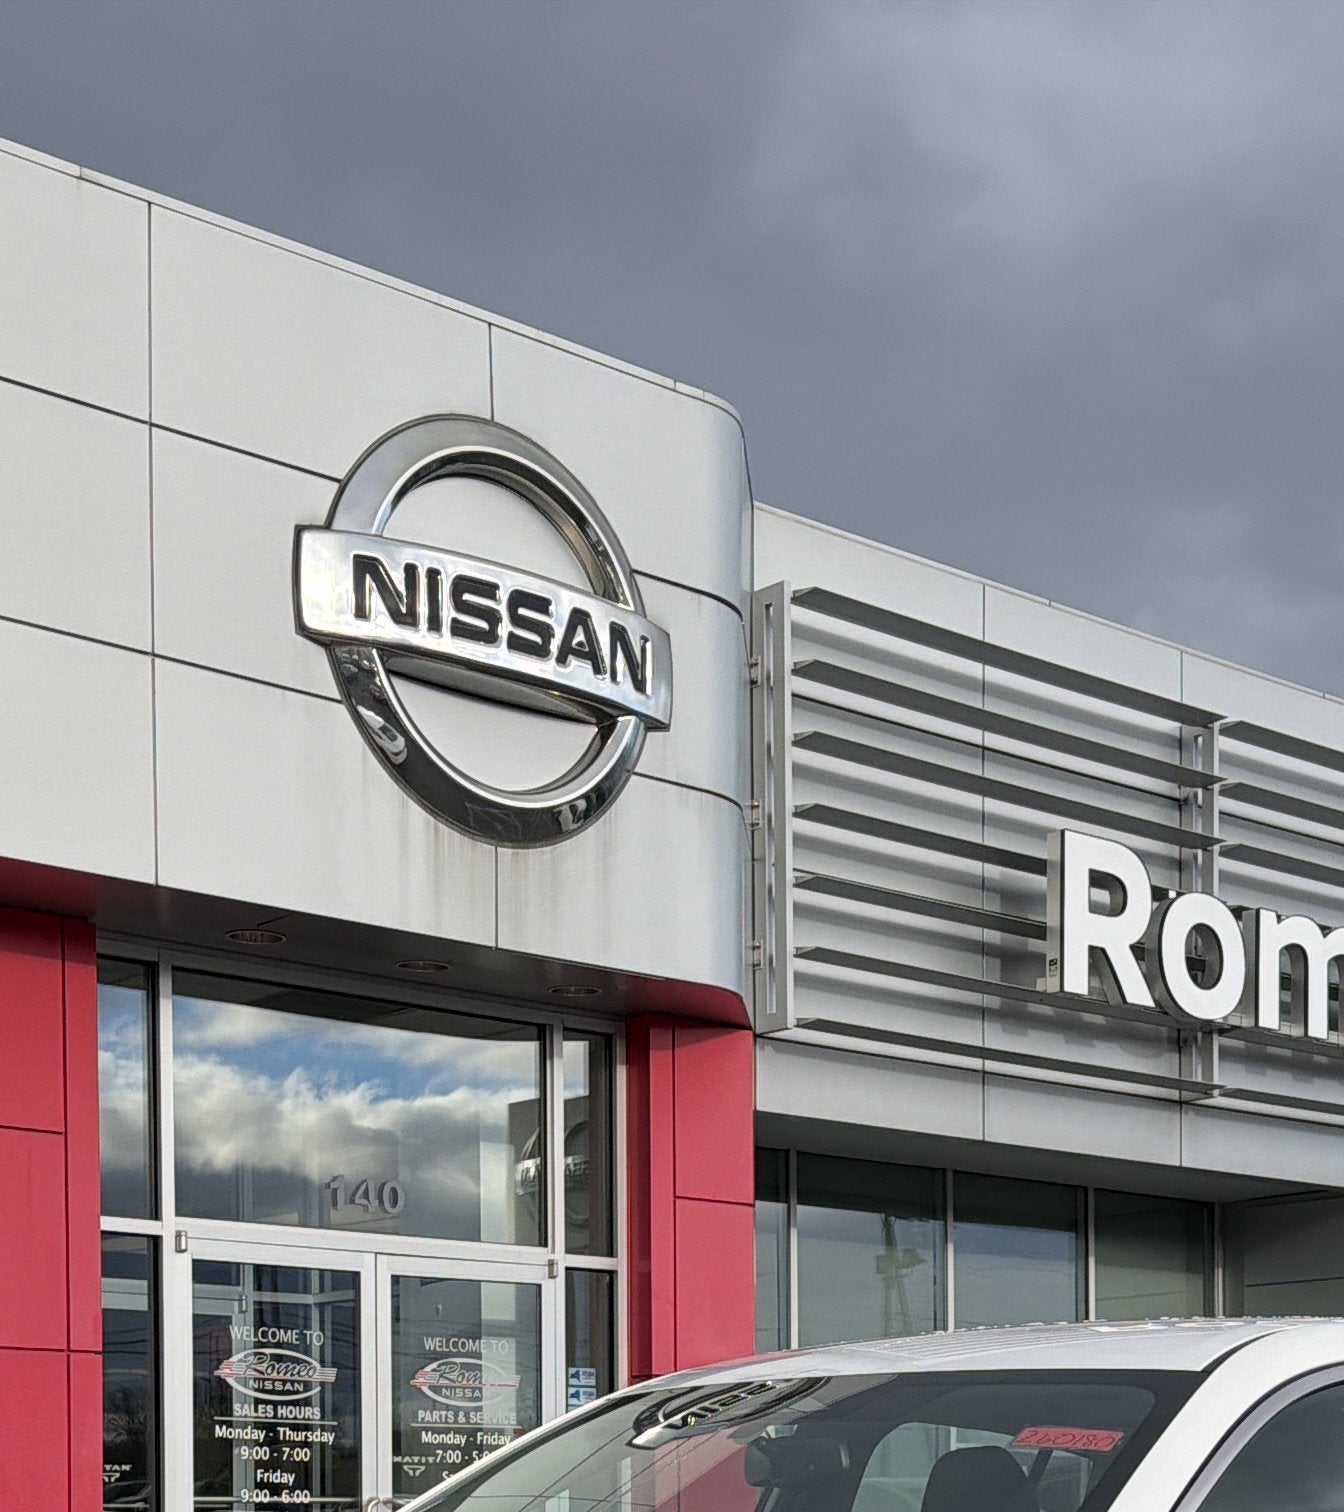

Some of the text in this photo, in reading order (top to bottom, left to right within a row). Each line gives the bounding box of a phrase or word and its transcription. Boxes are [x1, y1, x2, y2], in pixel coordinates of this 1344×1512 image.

[351, 552, 652, 697] NISSAN
[326, 1175, 405, 1214] 140
[229, 1325, 324, 1346] WELCOME TO
[424, 1336, 509, 1353] WELCOME TO
[242, 1352, 316, 1378] Romeo
[249, 1380, 304, 1392] NISSAN
[442, 1388, 482, 1398] NISSA
[233, 1404, 321, 1420] SALES HOURS
[418, 1409, 517, 1425] PARTS & SERVICE
[215, 1424, 266, 1443] Monday
[277, 1426, 335, 1445] Thursday
[421, 1430, 467, 1447] Monday
[476, 1431, 511, 1446] Friday
[240, 1446, 270, 1460] 9:00
[282, 1447, 311, 1461] 7:00
[435, 1449, 461, 1463] 7:00
[256, 1469, 296, 1486] Friday
[240, 1489, 270, 1502] 9:00
[281, 1489, 311, 1503] 6:00
